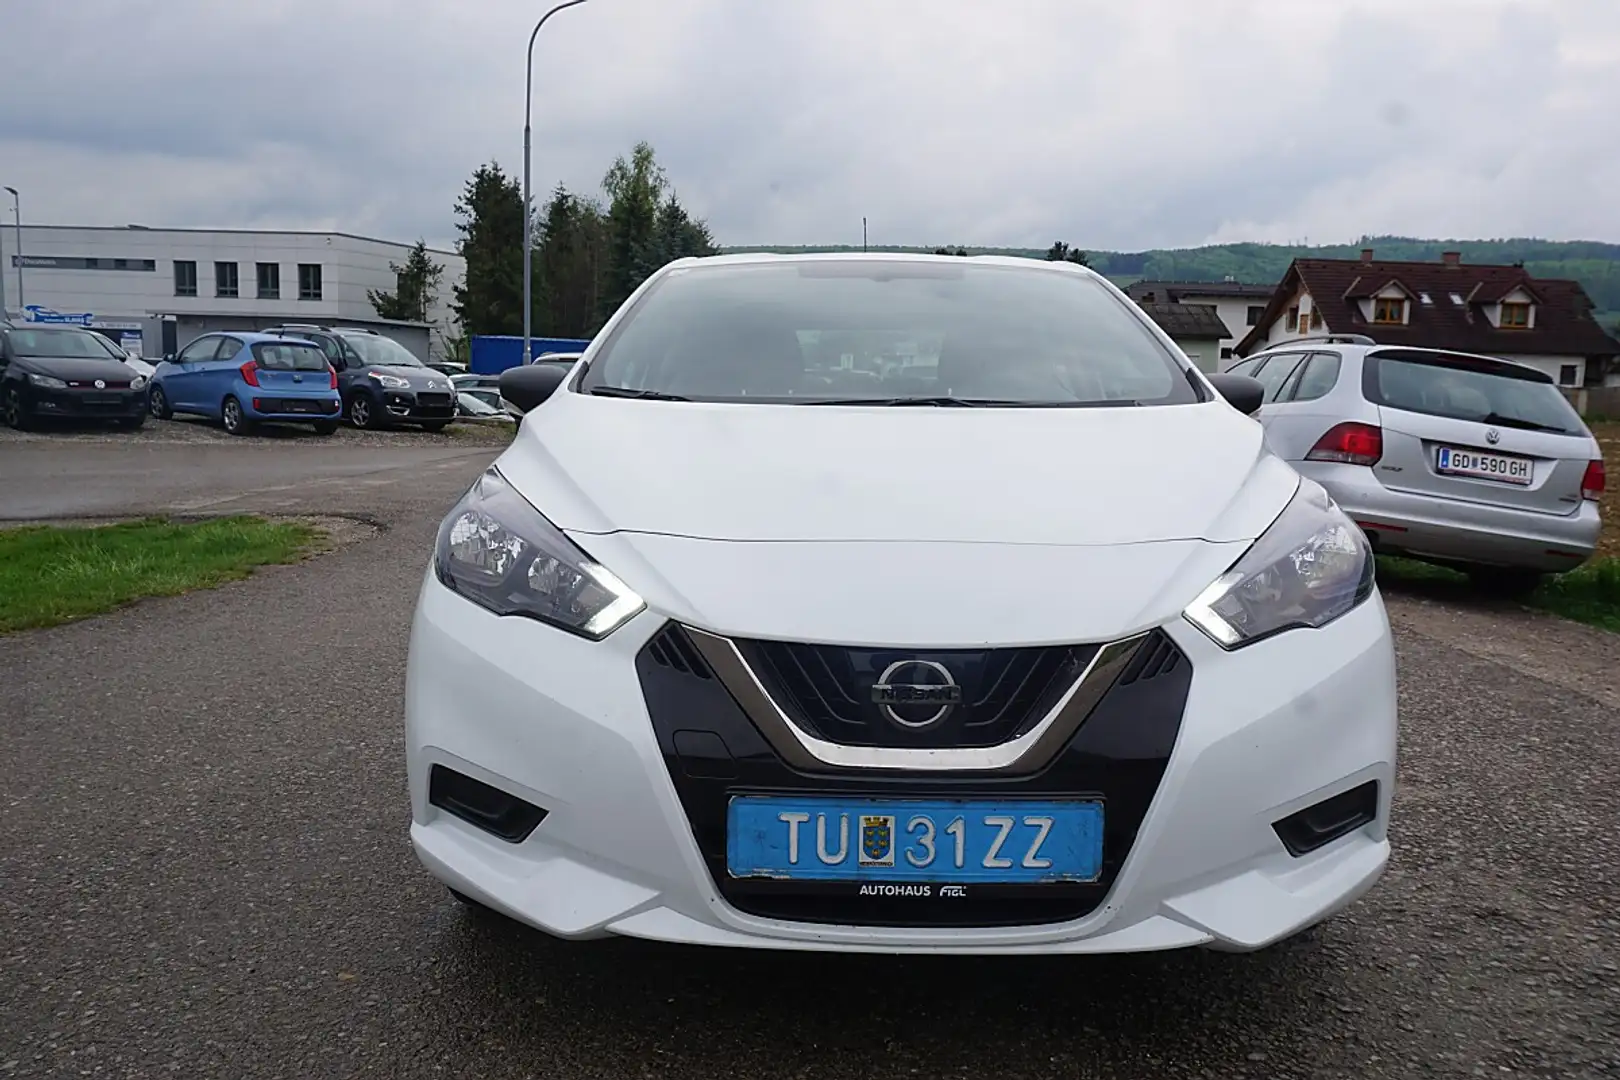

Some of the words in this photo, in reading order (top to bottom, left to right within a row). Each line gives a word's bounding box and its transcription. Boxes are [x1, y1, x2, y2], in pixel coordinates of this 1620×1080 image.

[1452, 453, 1470, 469] GD
[1480, 456, 1507, 474] 590
[1509, 461, 1527, 476] GH
[882, 687, 952, 701] NISSAN
[778, 811, 849, 865] TU
[859, 885, 932, 897] AUTOHAUS
